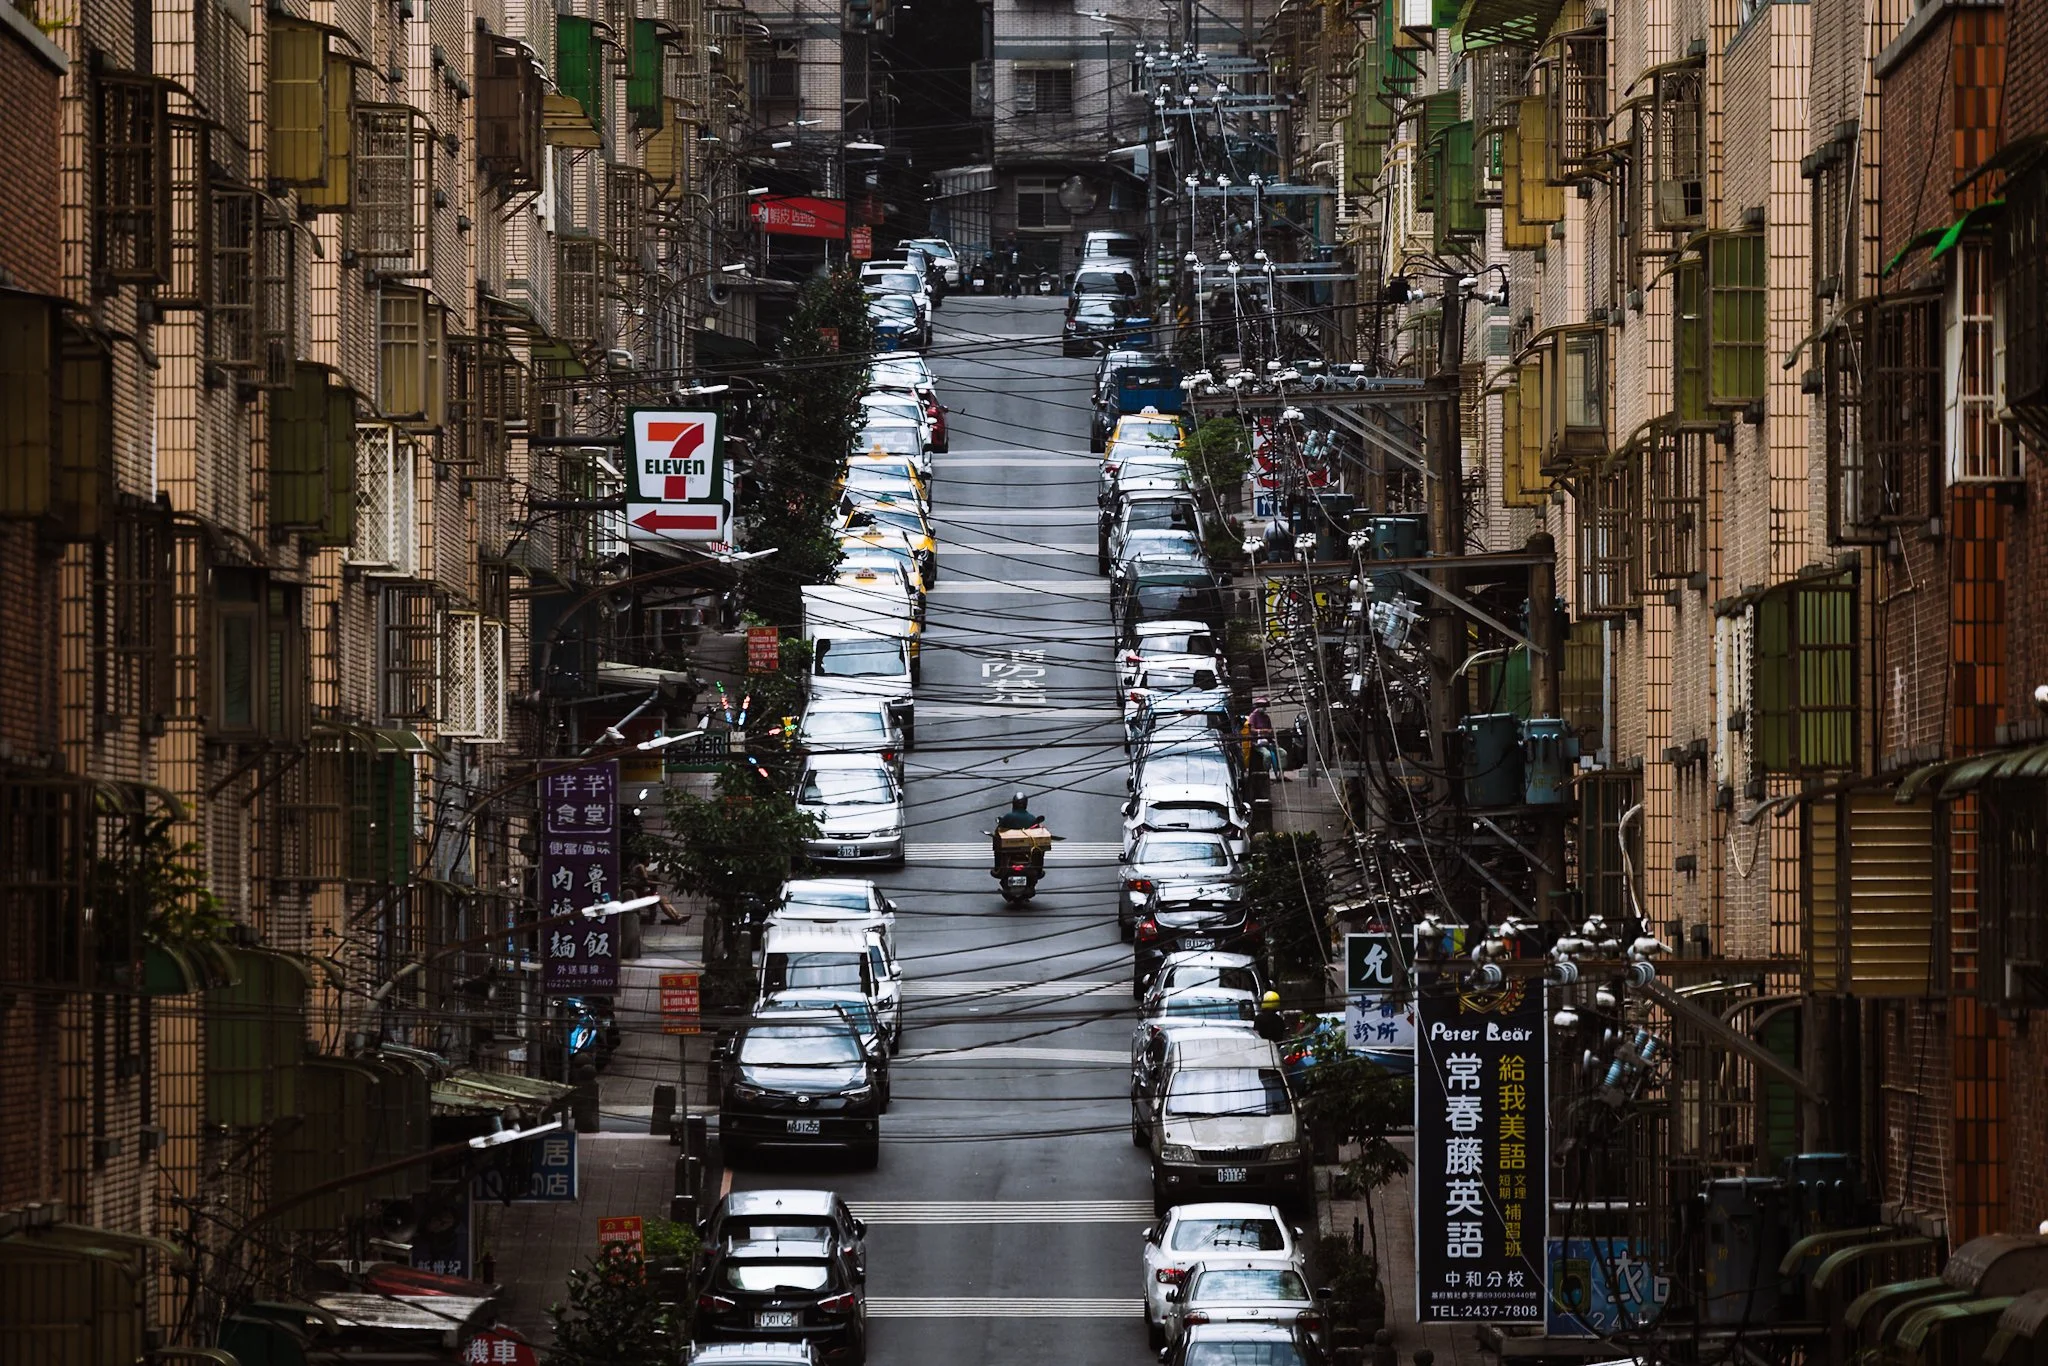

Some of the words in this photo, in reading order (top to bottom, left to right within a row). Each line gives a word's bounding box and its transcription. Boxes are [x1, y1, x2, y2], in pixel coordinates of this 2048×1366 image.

[648, 422, 704, 500] 7
[556, 803, 606, 826] 食堂
[1353, 1020, 1399, 1044] 診所
[1430, 1021, 1480, 1042] Peter
[1498, 1054, 1527, 1171] 給我美語
[1445, 1052, 1484, 1259] 常春藤英語
[1504, 1203, 1523, 1258] 補習班
[1445, 1269, 1526, 1289] 中和分校
[1430, 1304, 1539, 1318] TEL:2437-7808
[463, 1338, 519, 1366] 機車
